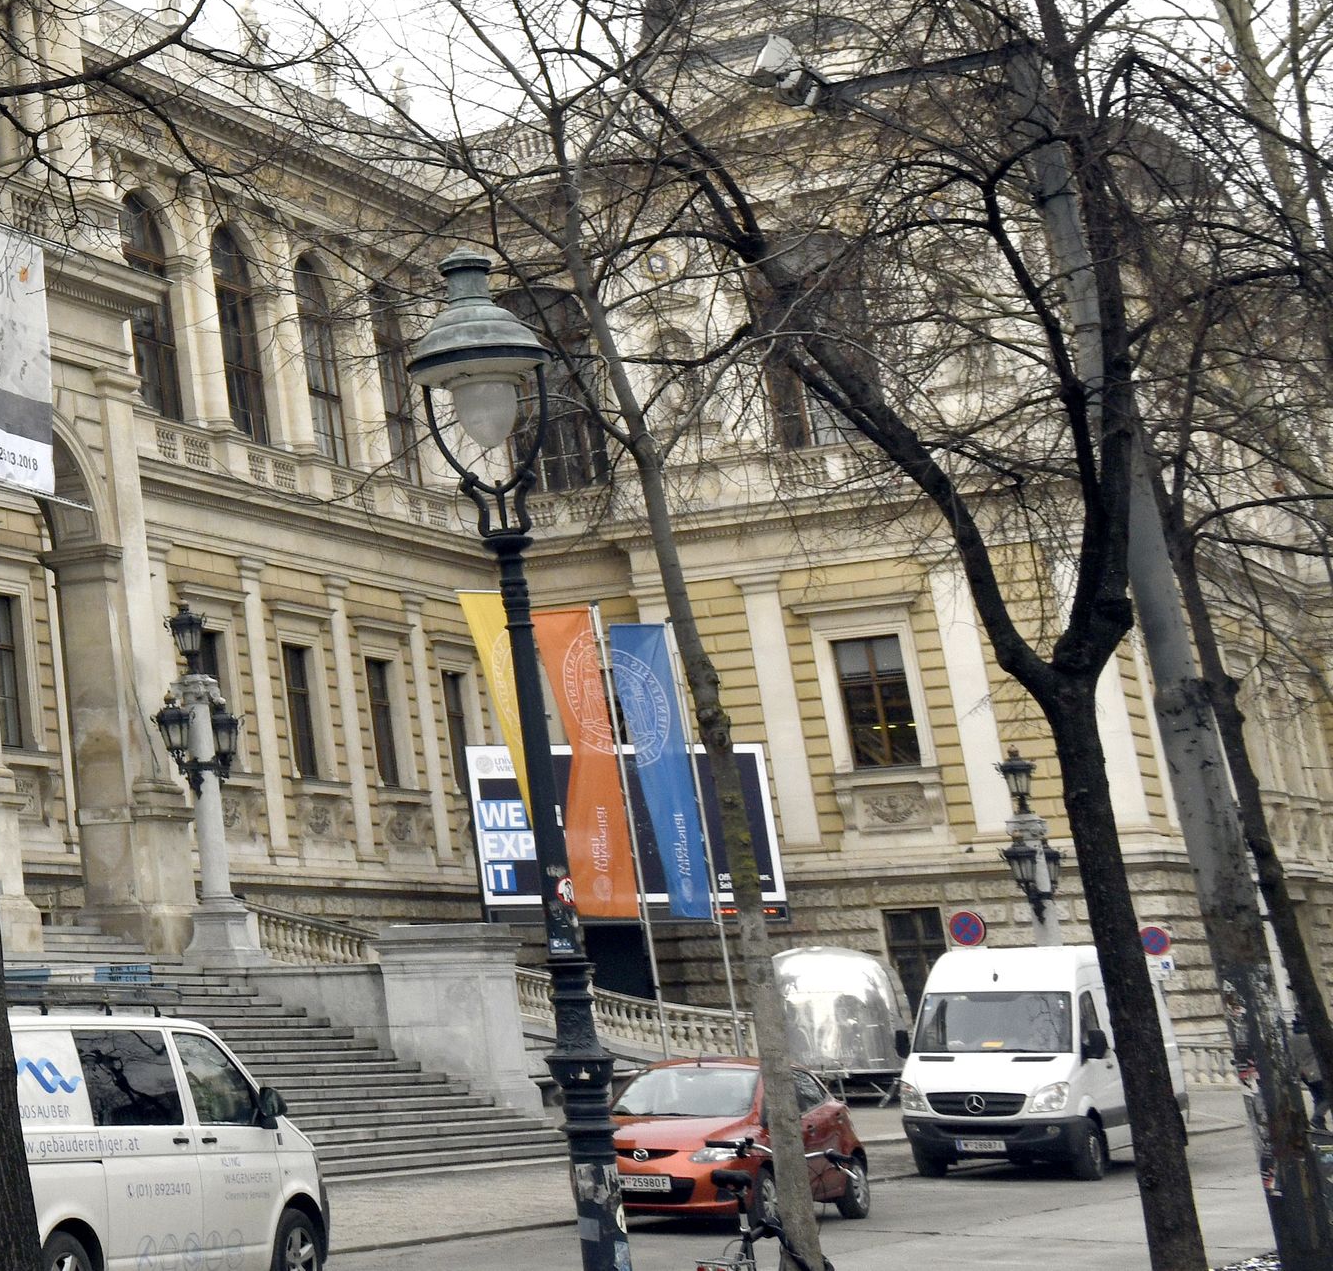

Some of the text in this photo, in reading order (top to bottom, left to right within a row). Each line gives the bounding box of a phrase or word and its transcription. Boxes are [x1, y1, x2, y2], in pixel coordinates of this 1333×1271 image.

[479, 802, 526, 828] WE
[483, 833, 534, 859] EXP
[486, 863, 513, 891] IT
